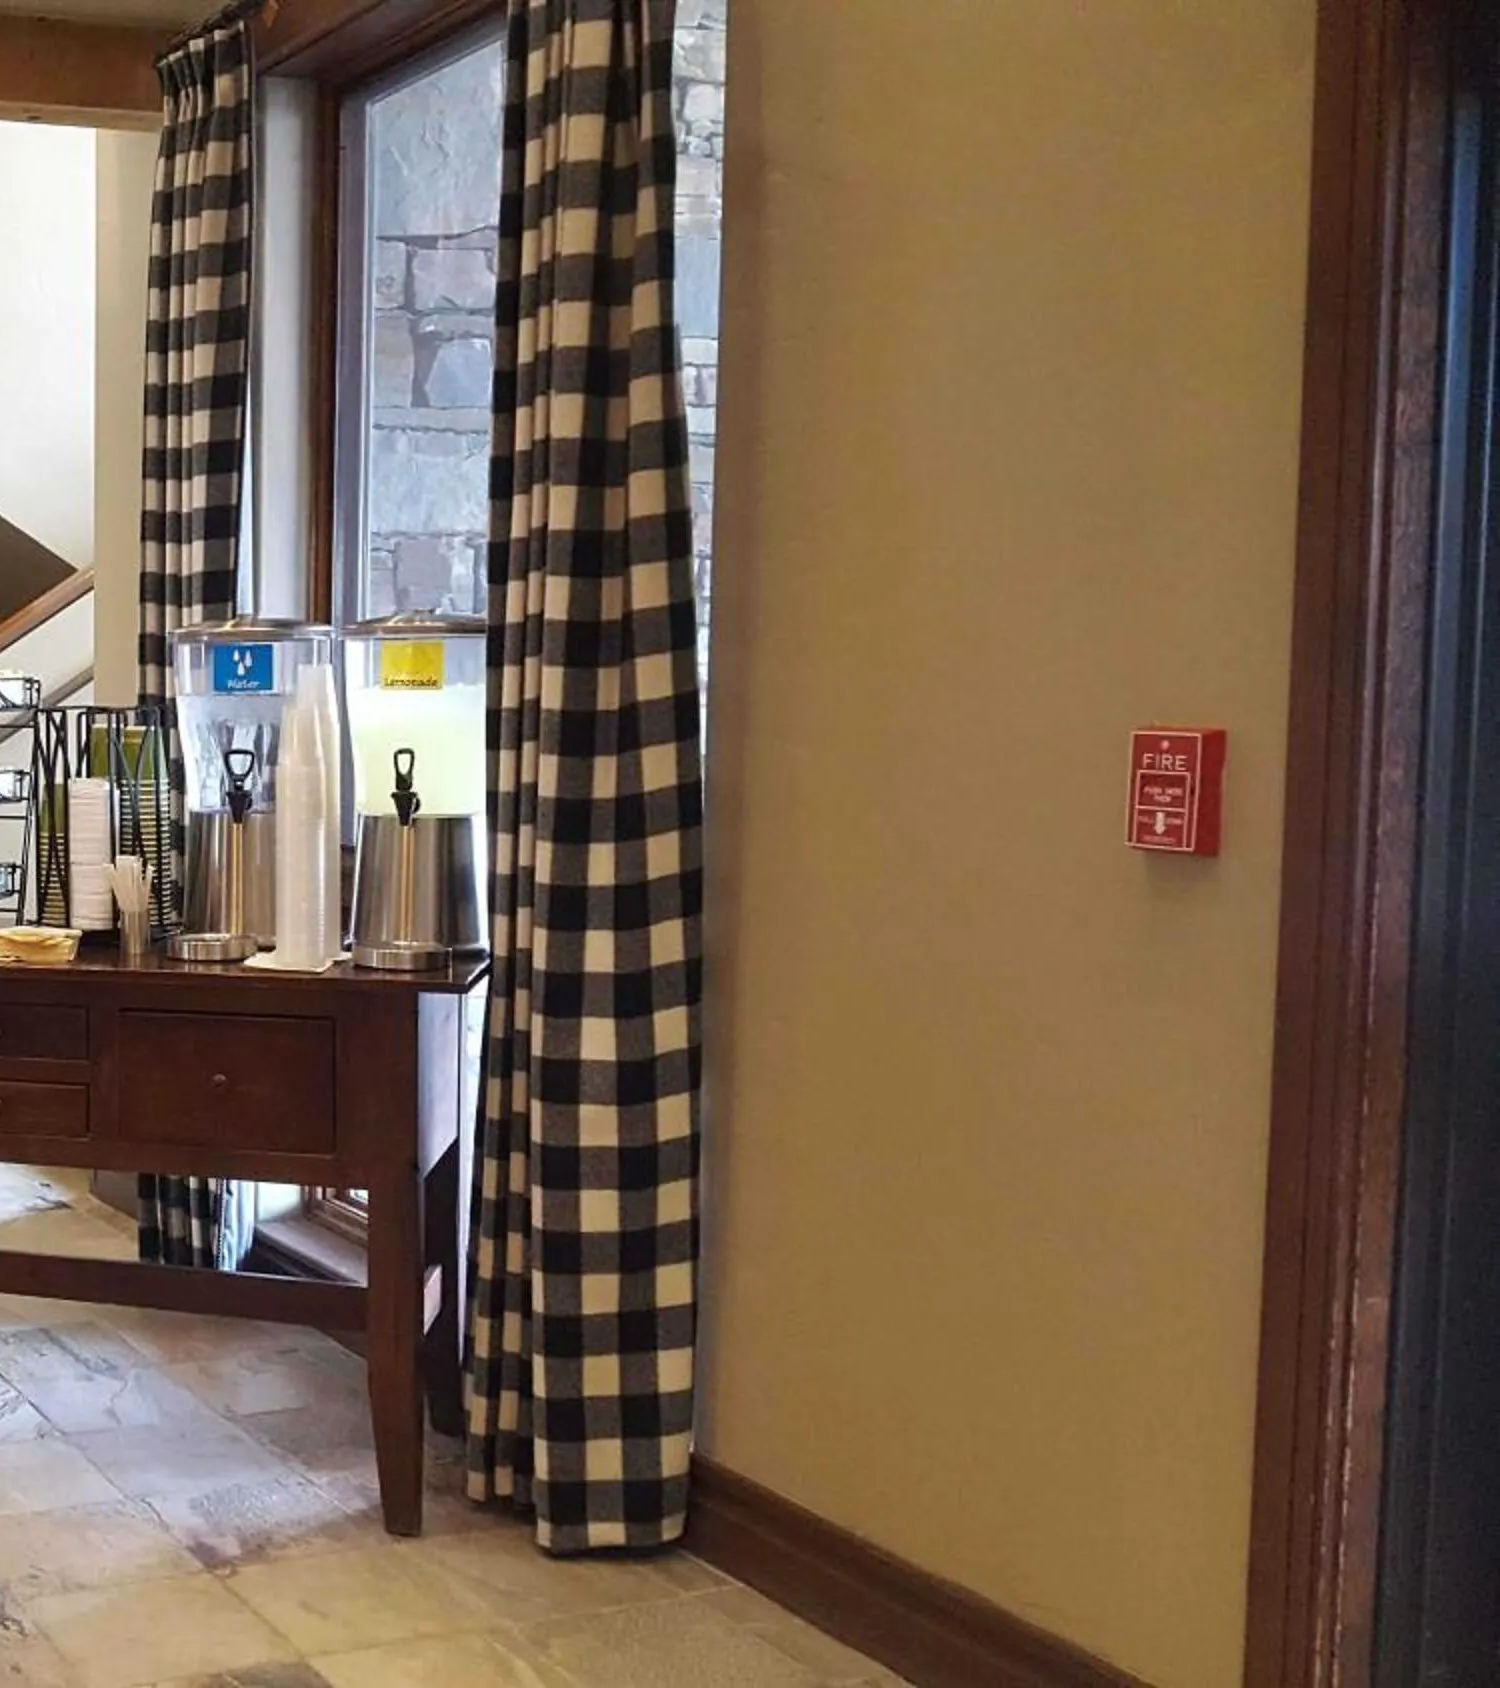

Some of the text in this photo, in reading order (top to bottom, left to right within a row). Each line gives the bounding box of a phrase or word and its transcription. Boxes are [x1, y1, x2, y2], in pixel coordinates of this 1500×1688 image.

[227, 679, 260, 689] Water
[384, 675, 438, 687] Lemonade
[1142, 753, 1188, 770] FIRE
